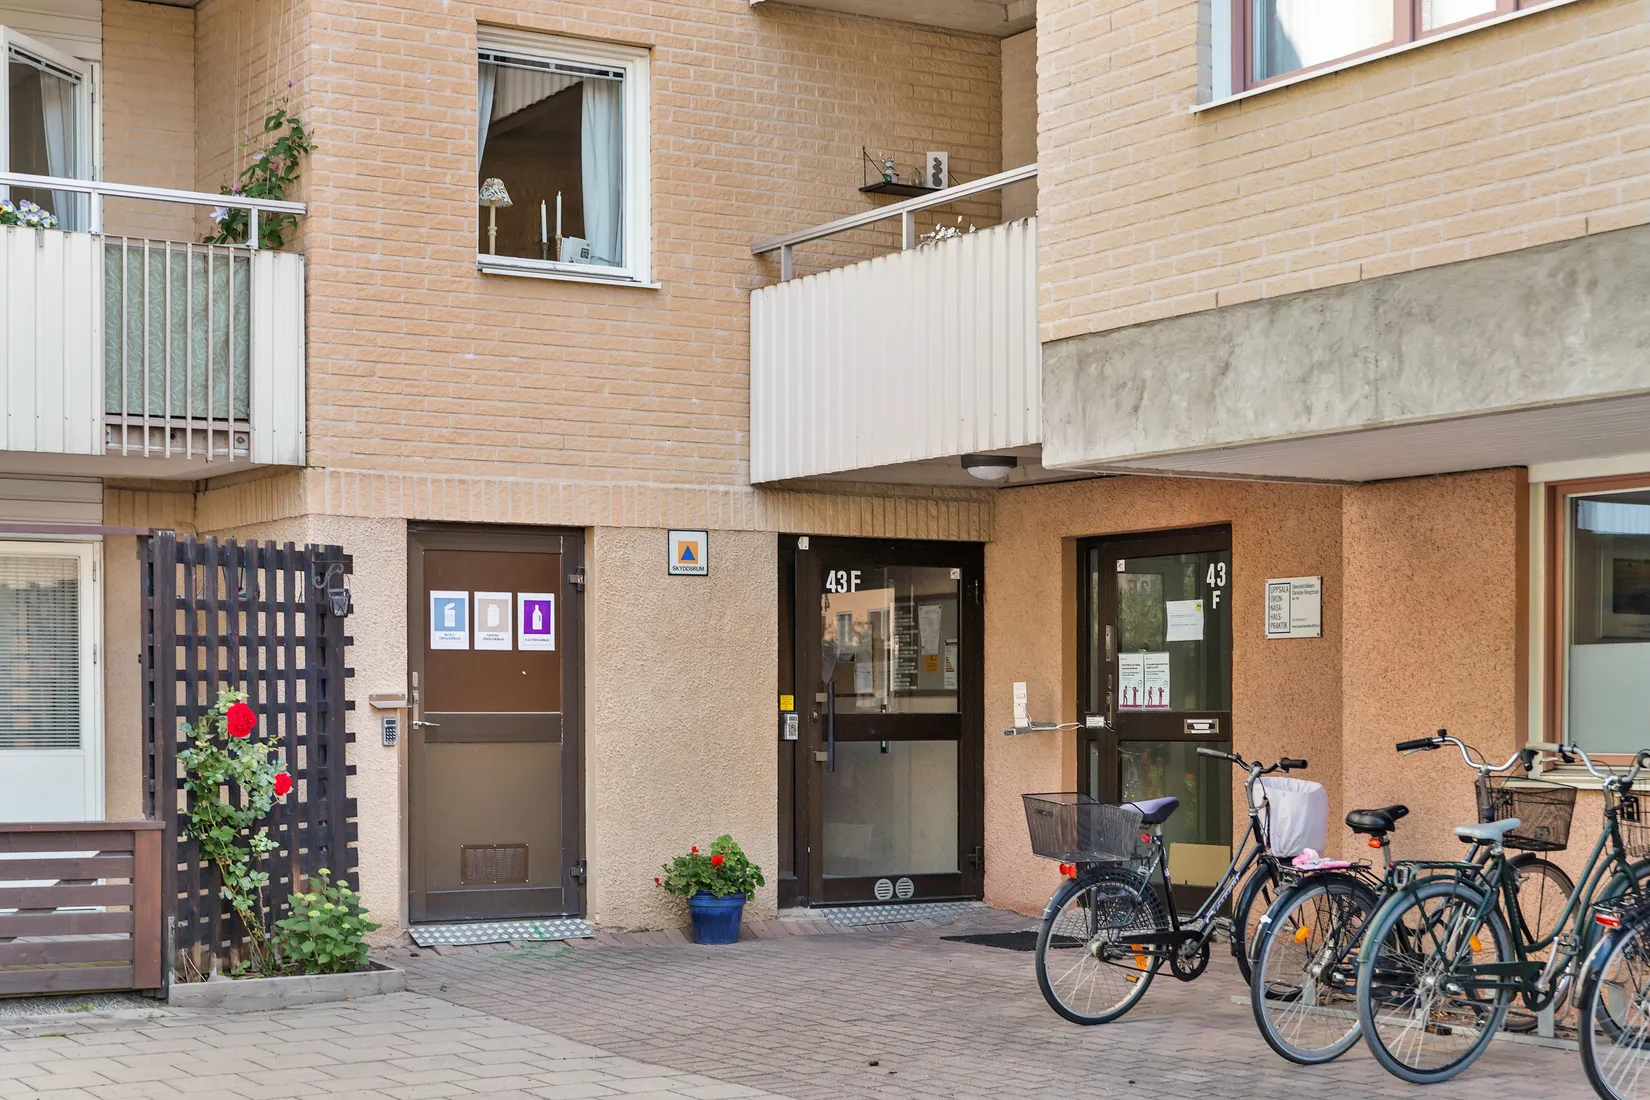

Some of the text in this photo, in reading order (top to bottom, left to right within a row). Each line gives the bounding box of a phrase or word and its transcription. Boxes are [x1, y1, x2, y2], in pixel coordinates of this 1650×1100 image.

[1206, 562, 1226, 587] 43
[1271, 585, 1289, 593] UPPSALA
[1212, 590, 1221, 609] F
